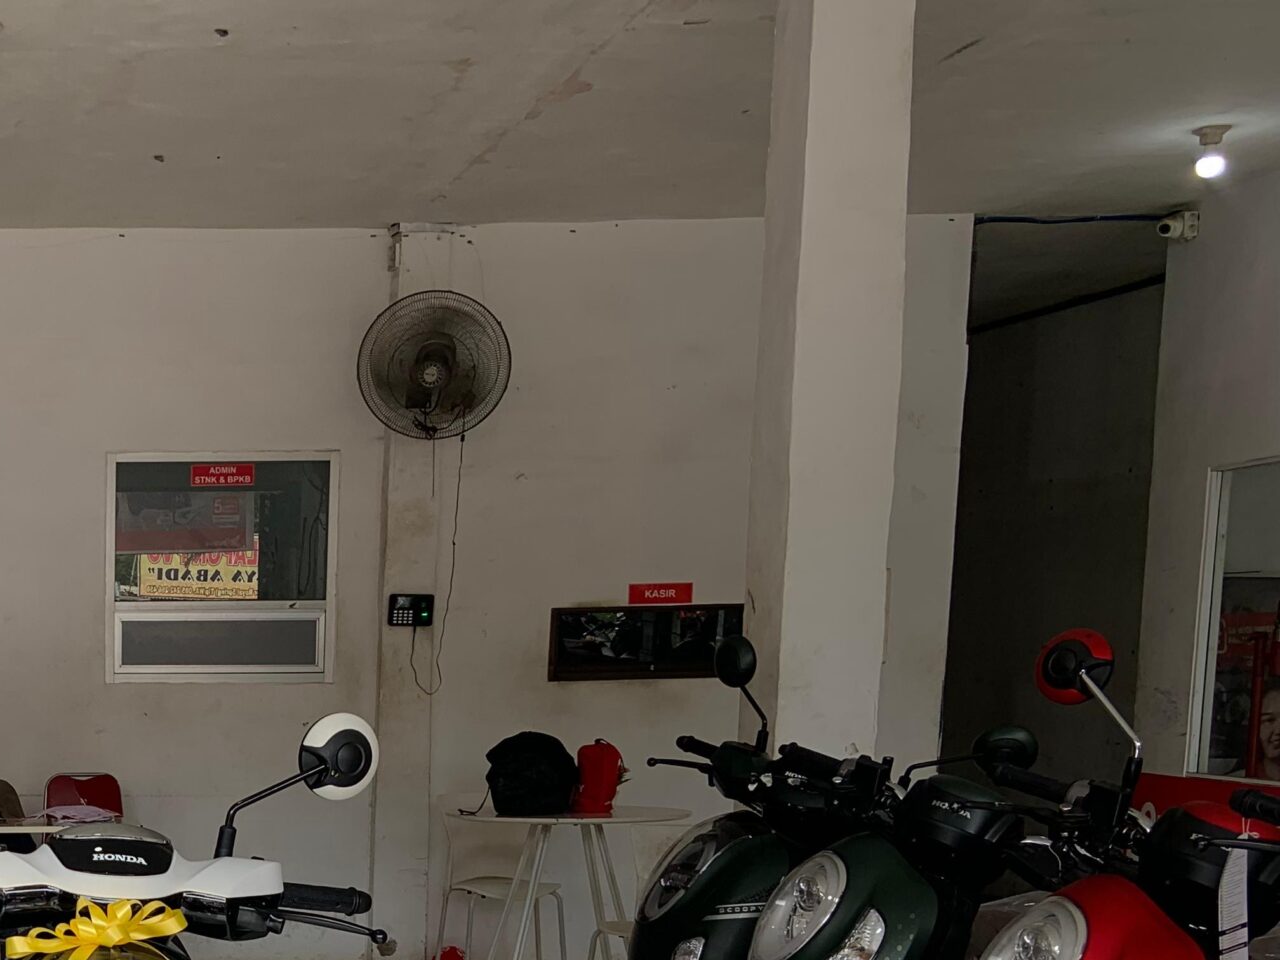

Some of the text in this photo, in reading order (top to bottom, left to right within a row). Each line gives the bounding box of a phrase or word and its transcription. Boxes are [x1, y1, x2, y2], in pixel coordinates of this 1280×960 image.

[209, 466, 237, 475] ADMIN
[194, 475, 251, 484] STNK & BPKB
[645, 589, 676, 598] KASIR
[92, 853, 148, 866] HONDA
